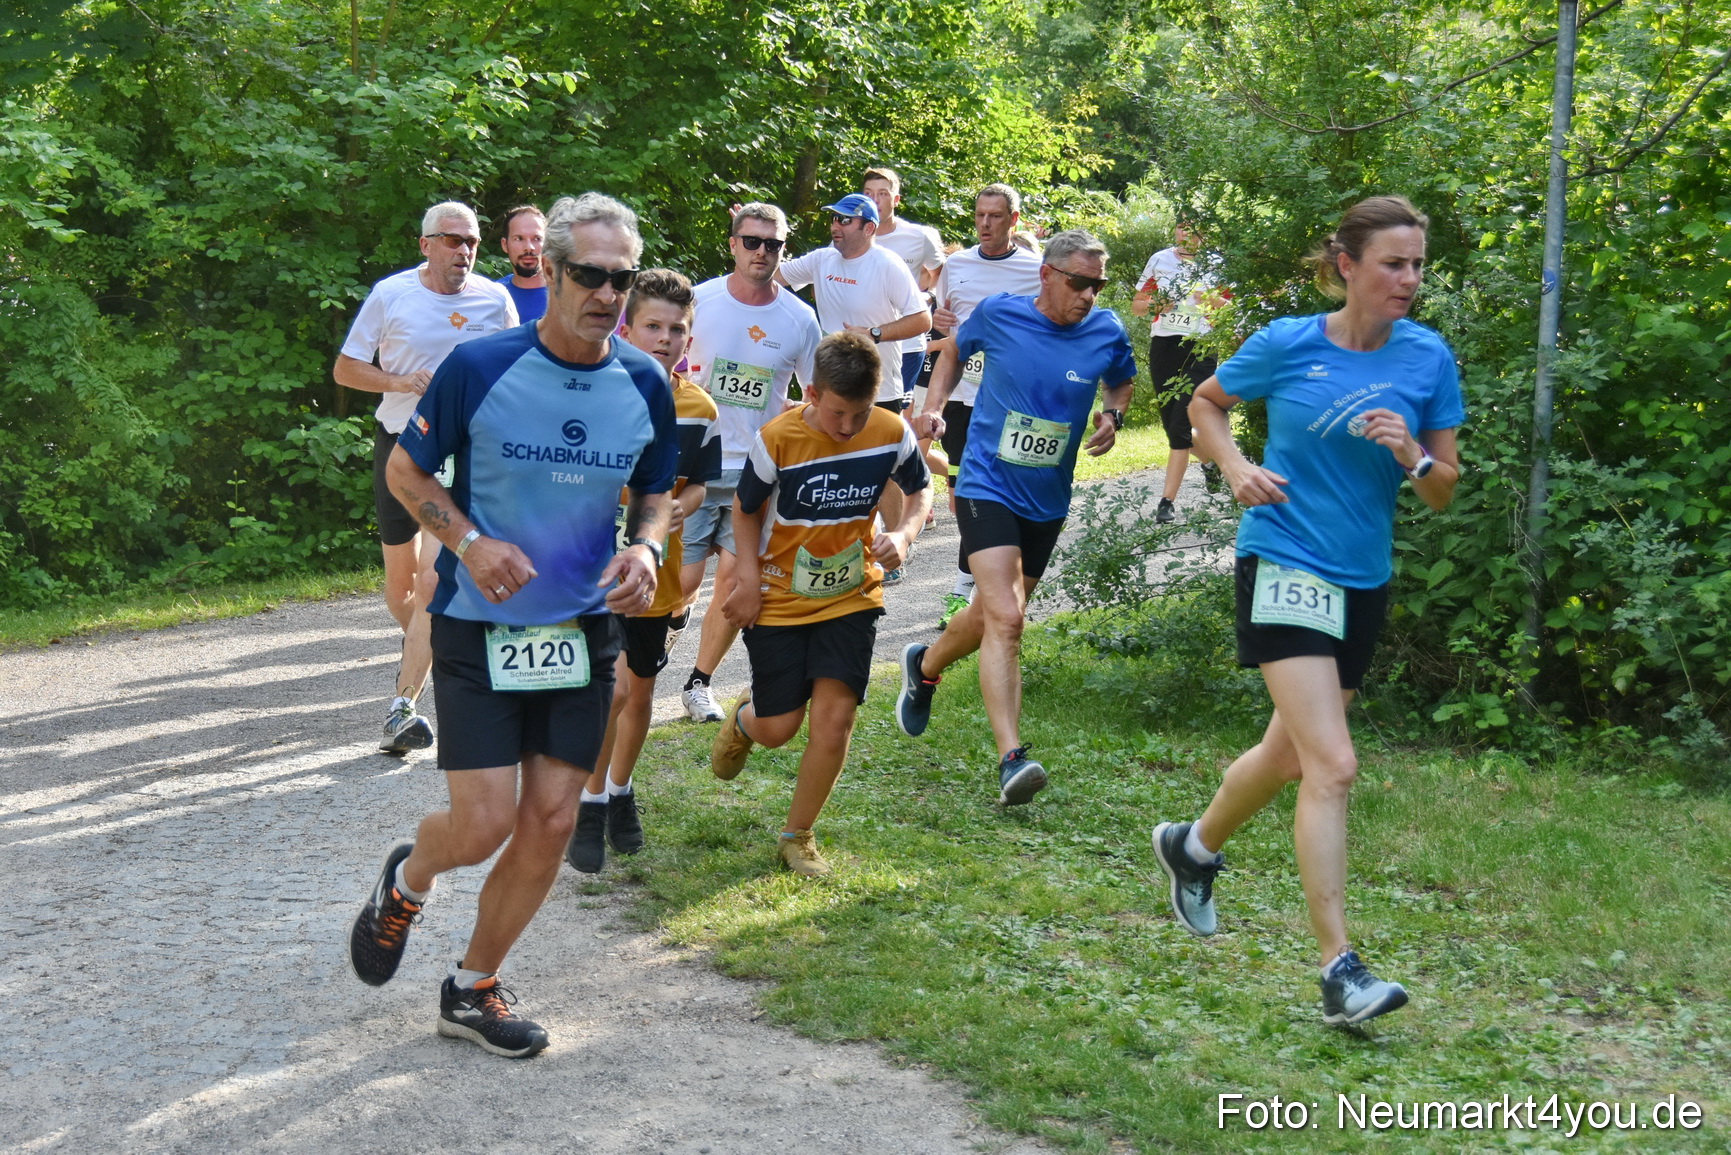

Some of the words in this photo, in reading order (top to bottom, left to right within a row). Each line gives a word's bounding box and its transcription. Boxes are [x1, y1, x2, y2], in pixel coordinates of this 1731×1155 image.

[1169, 313, 1190, 326] 374
[718, 375, 763, 397] 1345
[1306, 408, 1334, 432] Team
[1333, 387, 1369, 408] Schick
[1368, 381, 1392, 392] Bau
[1010, 431, 1059, 455] 1088
[501, 442, 633, 470] SCHABMÜLLER
[551, 471, 584, 484] TEAM
[811, 473, 878, 503] Fischer
[817, 498, 872, 511] AUTOMOBILE
[808, 565, 850, 588] 782
[1268, 581, 1331, 615] 1531
[1260, 604, 1310, 614] Schick-Huber
[1311, 610, 1337, 625] Gerlinde
[500, 640, 575, 670] 2120
[509, 669, 548, 678] Schneider
[550, 667, 572, 676] Alfred
